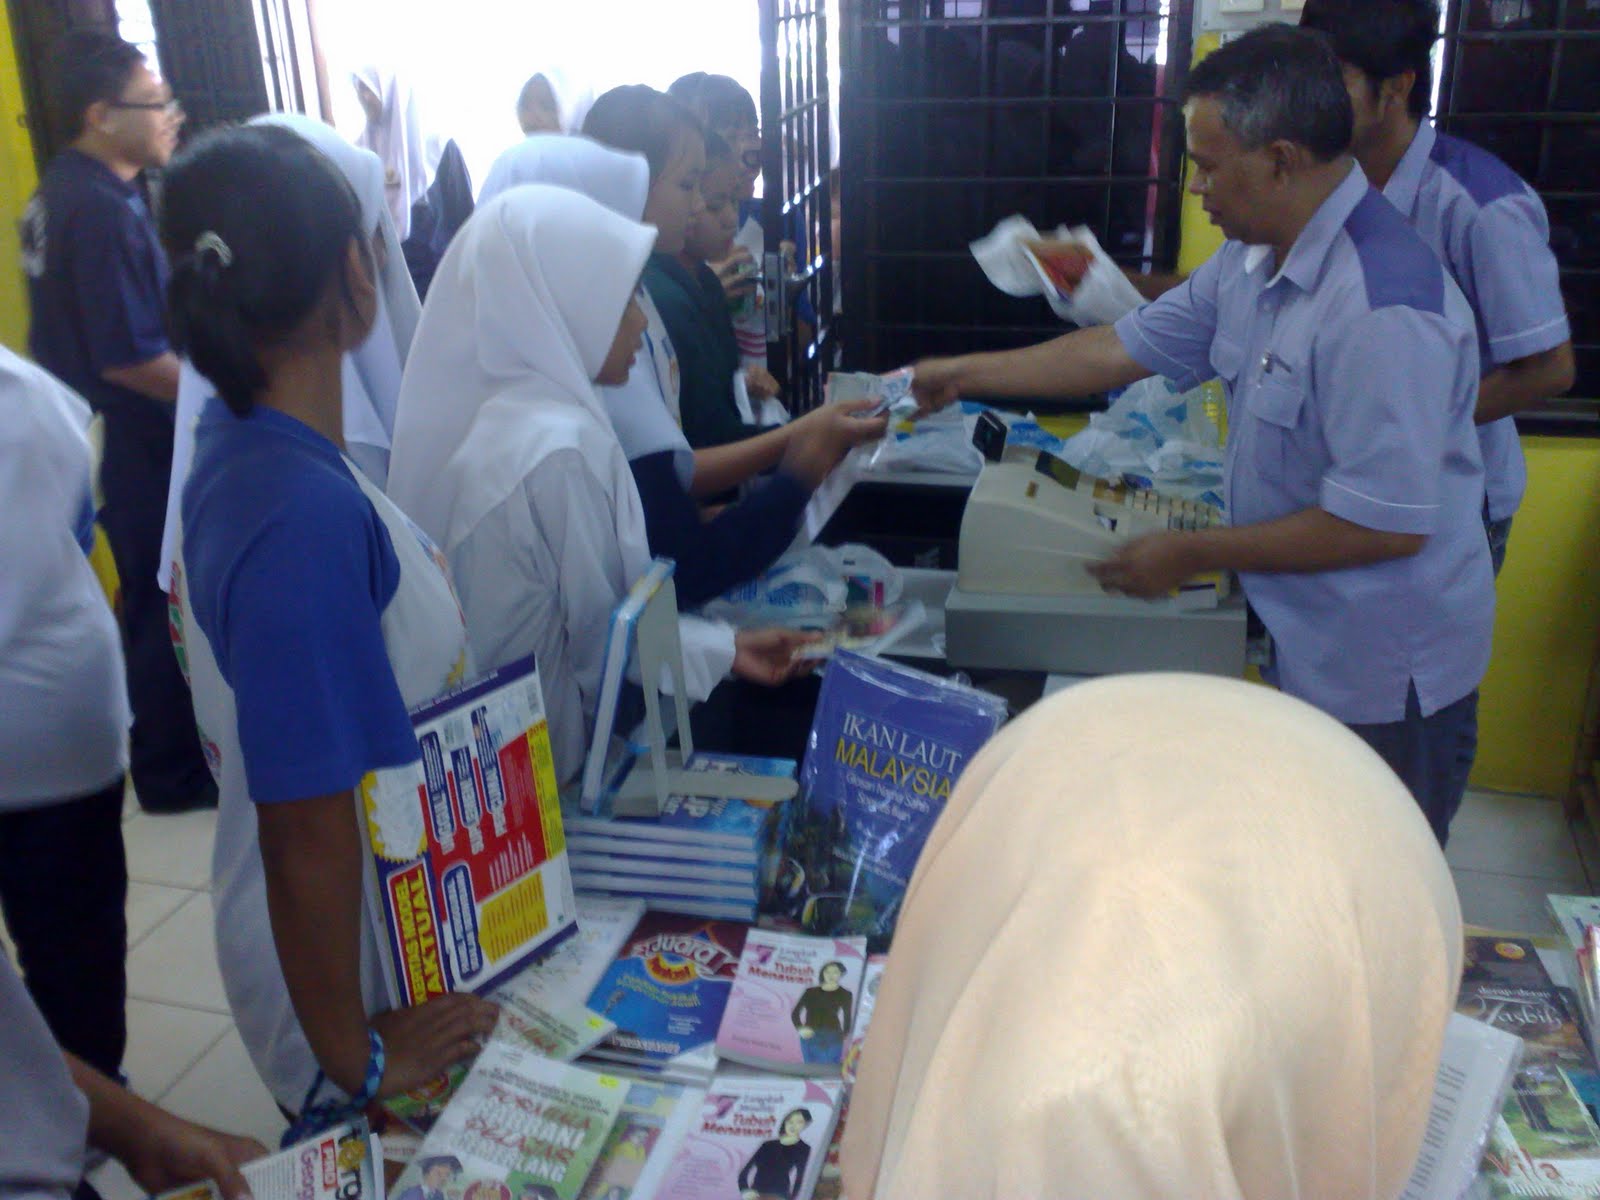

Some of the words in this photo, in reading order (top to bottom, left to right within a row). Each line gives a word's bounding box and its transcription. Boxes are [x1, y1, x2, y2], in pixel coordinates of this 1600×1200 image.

[843, 711, 896, 750] IKAN
[900, 732, 962, 774] LAUT
[835, 736, 952, 801] MALAYSIA
[410, 868, 443, 993] AKTUAL
[748, 966, 815, 985] Menawan
[774, 961, 815, 976] Tubuh
[702, 1121, 774, 1137] Menawan
[732, 1112, 777, 1128] Tubuh
